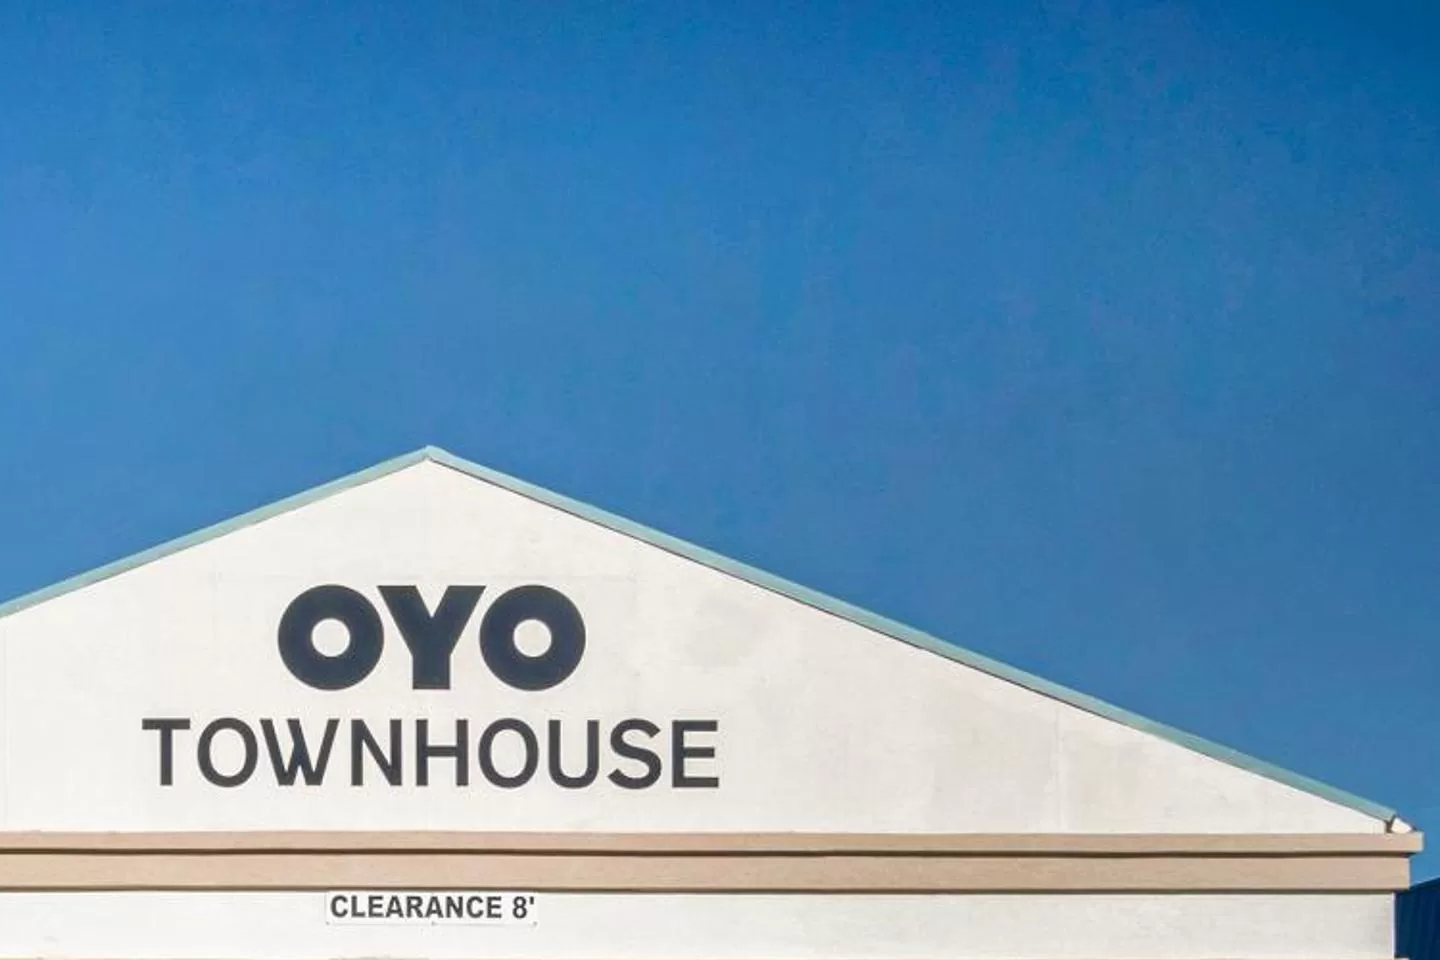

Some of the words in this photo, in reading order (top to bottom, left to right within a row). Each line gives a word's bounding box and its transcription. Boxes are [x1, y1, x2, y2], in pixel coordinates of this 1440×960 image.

[277, 584, 586, 692] OYO
[142, 717, 720, 790] TOWNHOUSE
[330, 895, 502, 919] CLEARANCE
[512, 896, 535, 919] 8'
